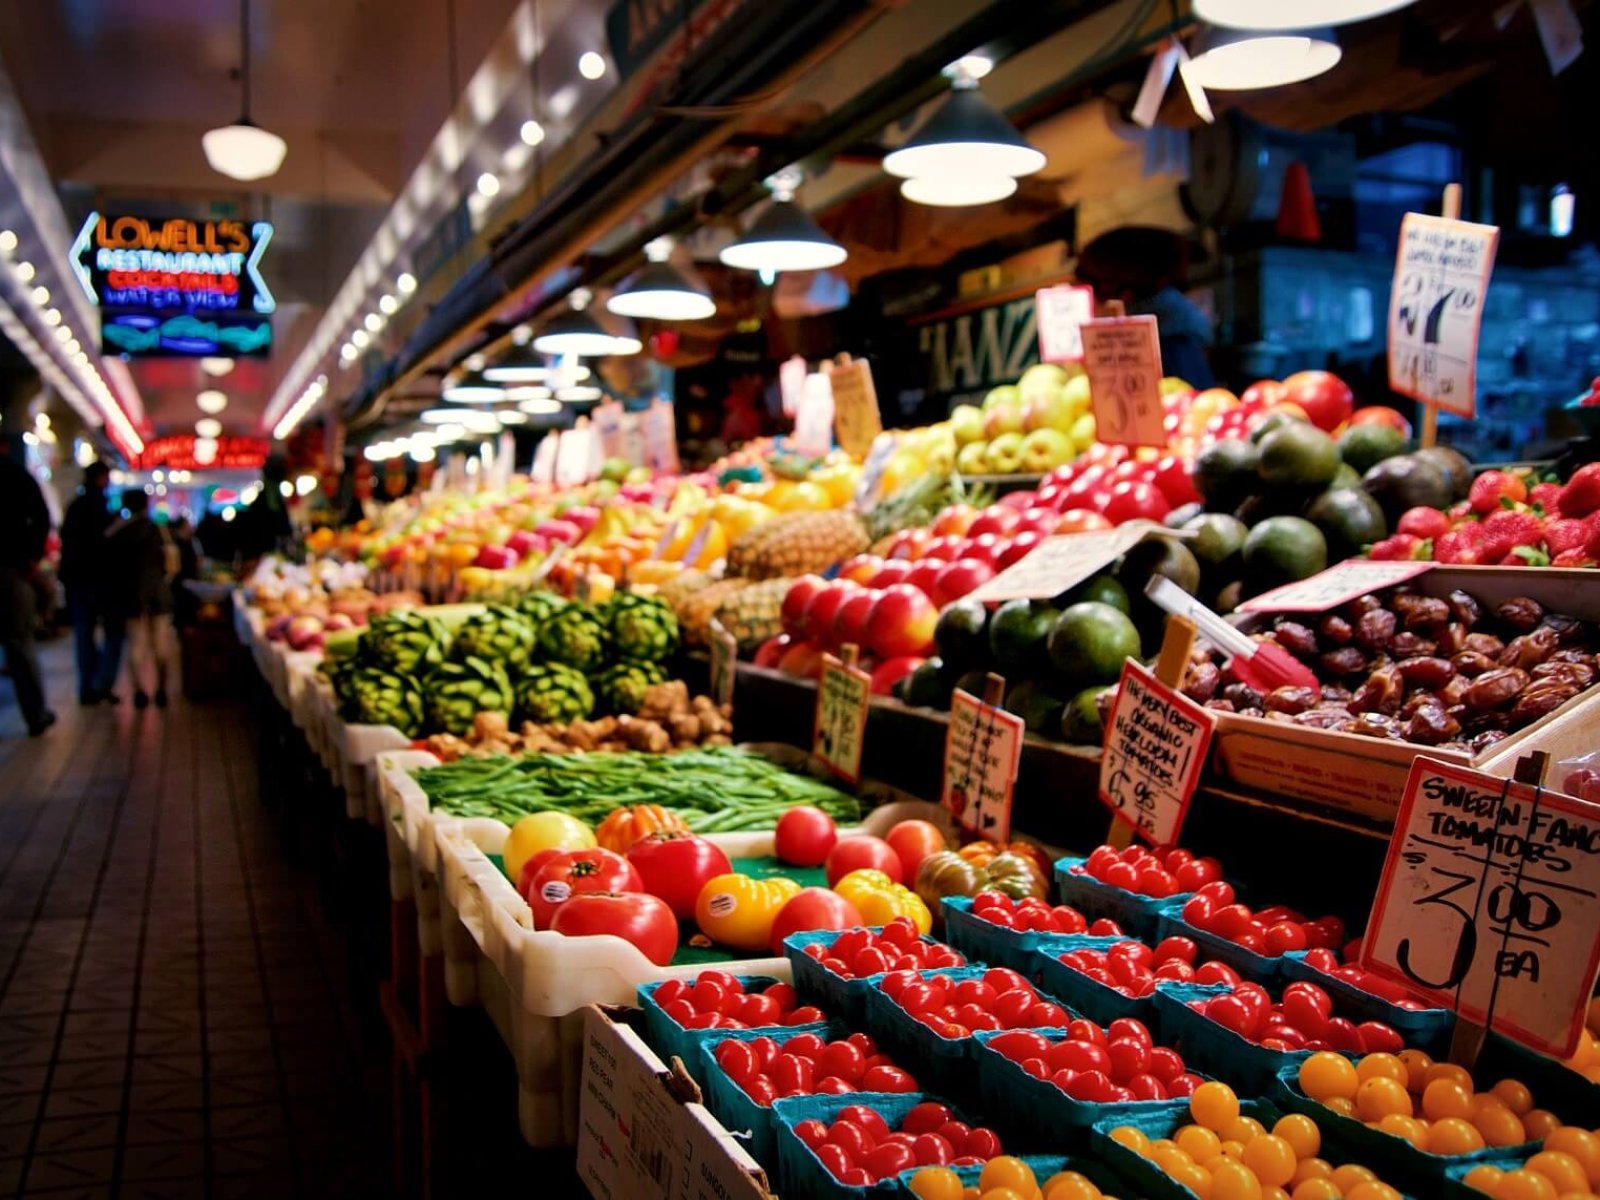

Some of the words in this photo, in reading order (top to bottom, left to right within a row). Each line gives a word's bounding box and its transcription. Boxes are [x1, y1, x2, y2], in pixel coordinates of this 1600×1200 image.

[96, 216, 250, 253] LOWELL'S
[97, 248, 245, 275] RESTAURANT
[1131, 708, 1183, 748] ORGANIC
[1428, 812, 1571, 872] TOMATOES
[1397, 866, 1477, 989] 3
[1495, 951, 1541, 984] EA
